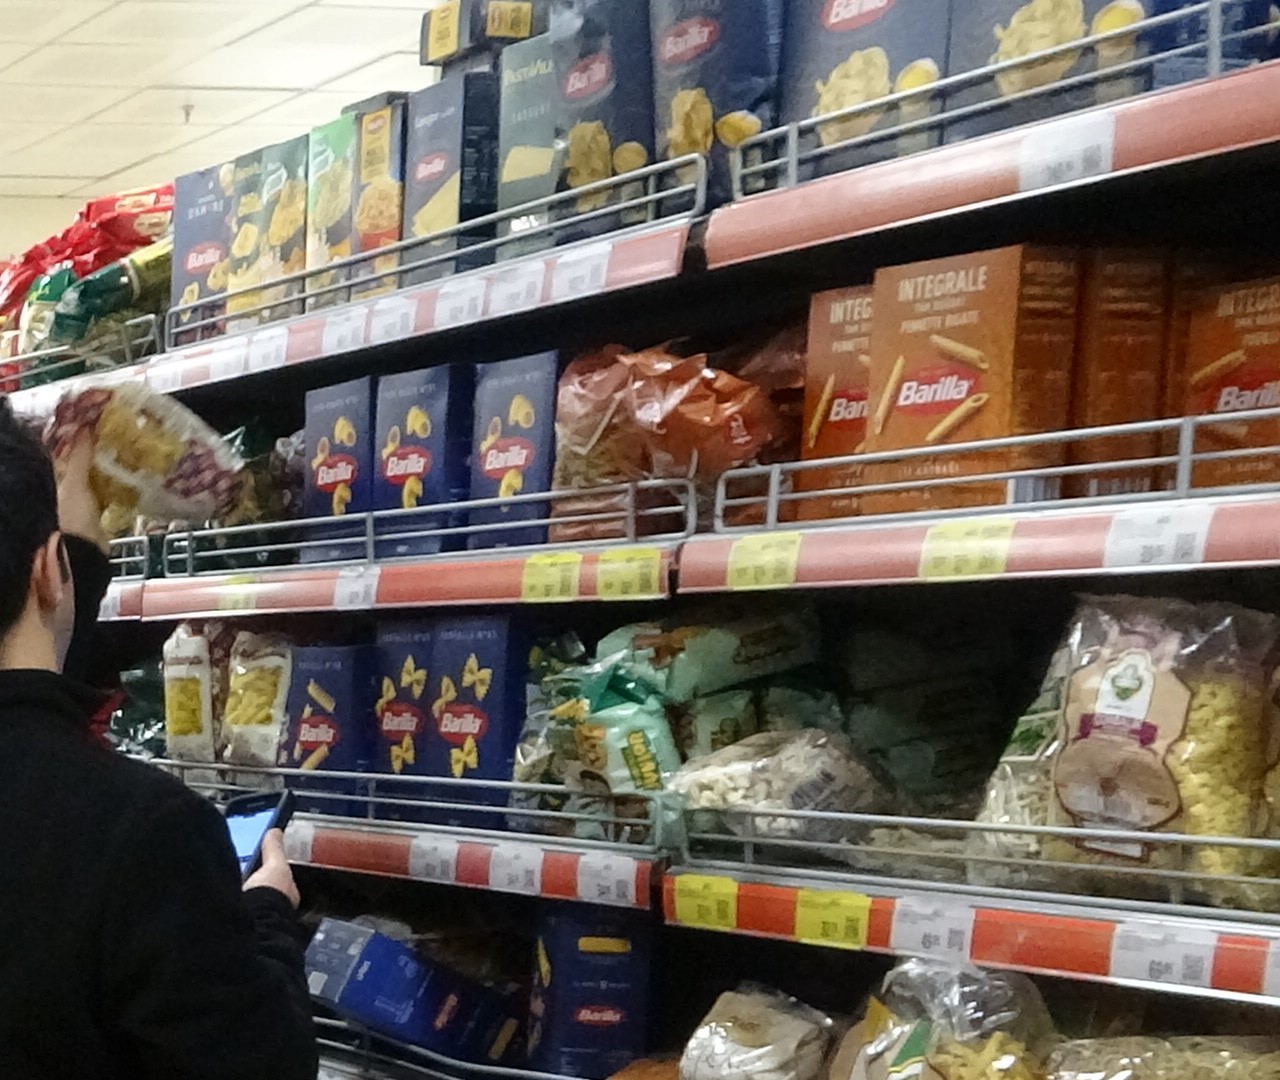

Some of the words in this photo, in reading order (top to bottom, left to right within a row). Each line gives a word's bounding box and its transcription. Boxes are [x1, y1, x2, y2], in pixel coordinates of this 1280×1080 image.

[662, 21, 718, 58] Barilla
[566, 60, 607, 93] Barilla
[187, 247, 222, 269] Barilla
[897, 265, 989, 302] INTEGRALE
[829, 298, 873, 324] INTEG
[895, 374, 971, 407] Barilla
[1216, 377, 1280, 411] Barill
[386, 452, 427, 477] Barilla
[485, 445, 528, 470] Barilla
[317, 462, 354, 486] Barilla
[299, 723, 336, 742] Barilla
[382, 711, 419, 731] Barilla
[440, 712, 483, 734] Barilla
